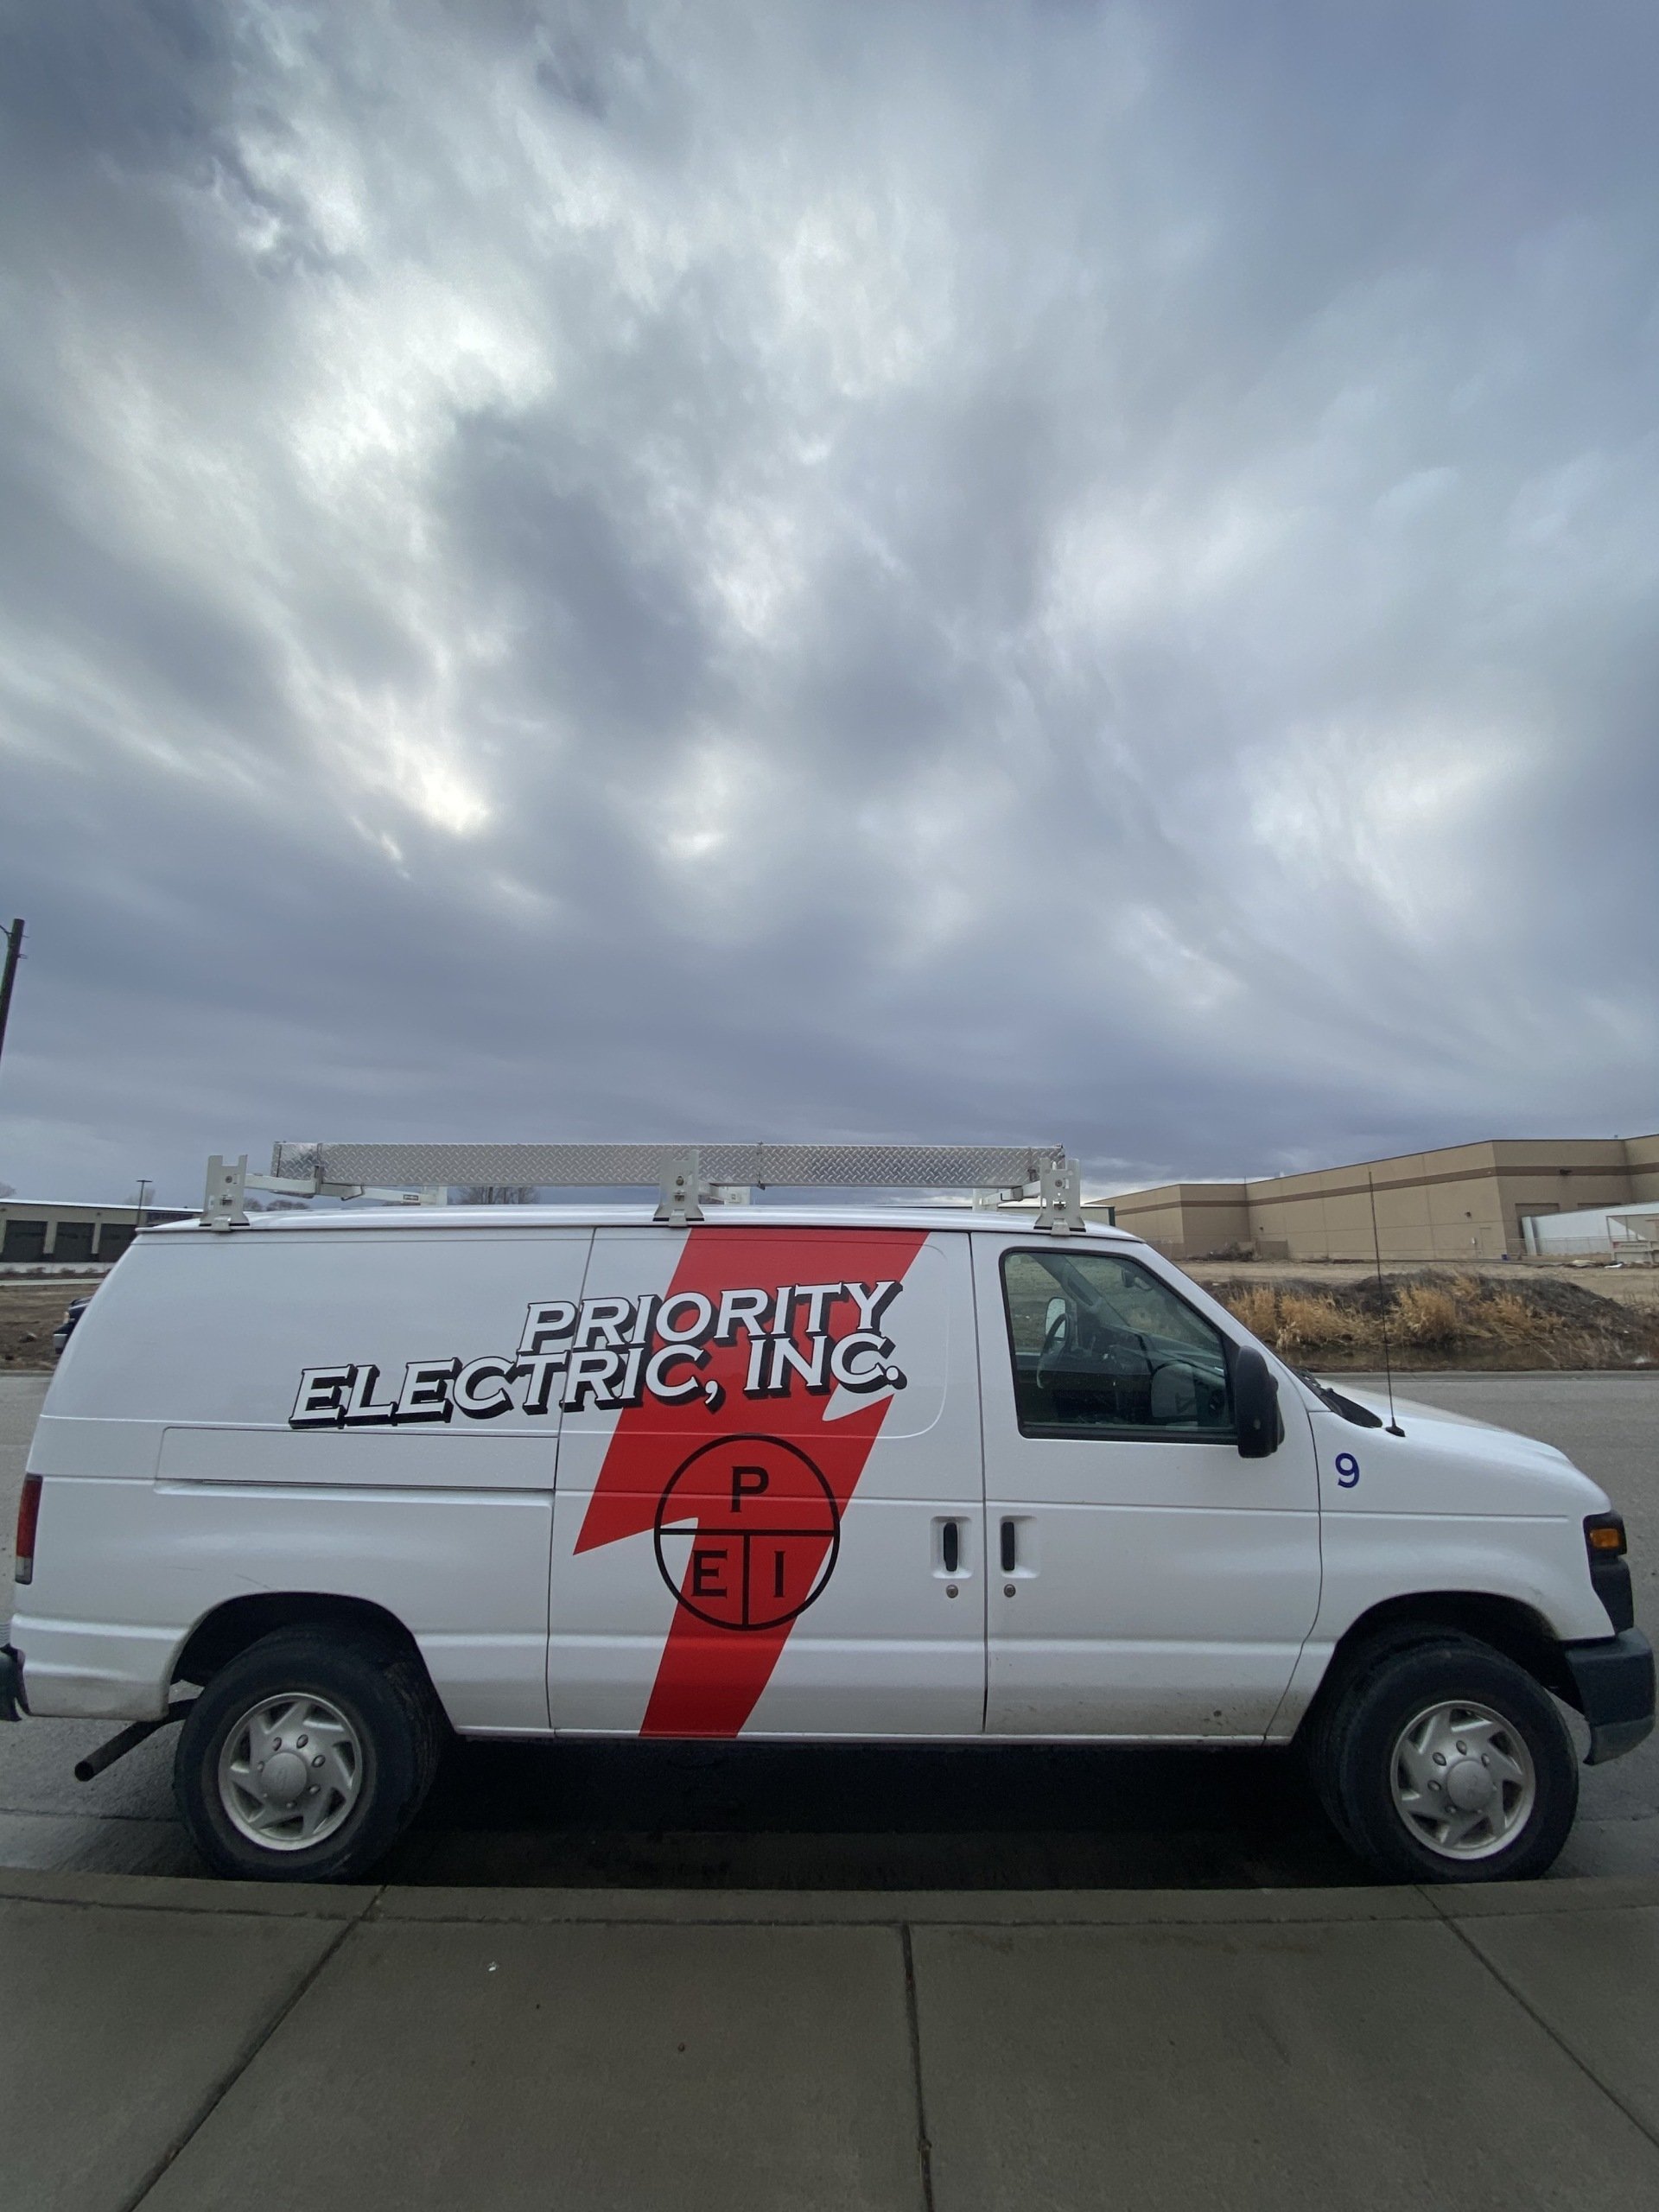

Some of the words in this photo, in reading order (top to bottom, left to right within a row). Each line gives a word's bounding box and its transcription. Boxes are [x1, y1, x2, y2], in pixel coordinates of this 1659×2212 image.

[517, 1280, 904, 1357] PRIORITY
[289, 1342, 727, 1430] ELECTRIC,
[743, 1332, 908, 1398] INC.
[729, 1465, 770, 1513] P
[1335, 1452, 1360, 1488] 9
[691, 1548, 728, 1599] E
[772, 1550, 785, 1599] I
